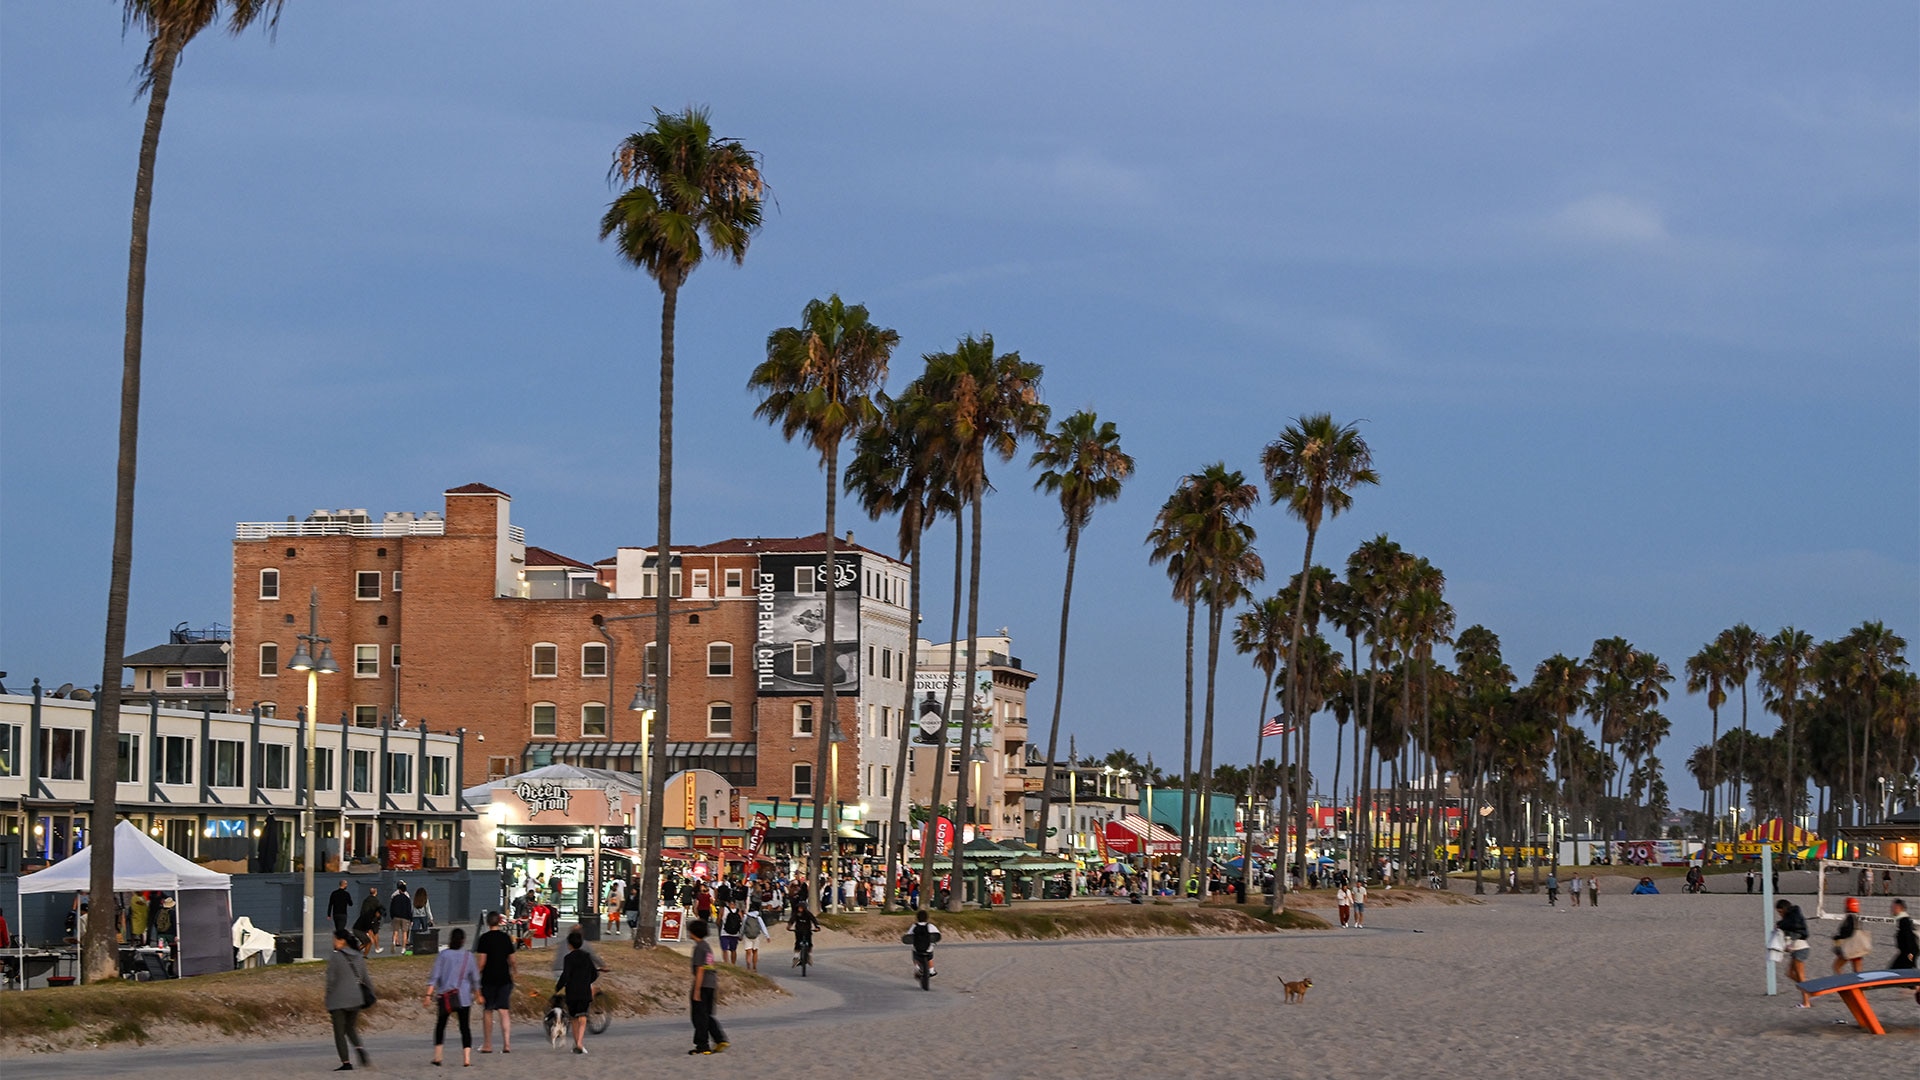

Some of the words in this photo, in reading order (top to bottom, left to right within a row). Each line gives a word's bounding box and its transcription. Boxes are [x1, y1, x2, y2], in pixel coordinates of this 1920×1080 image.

[817, 564, 857, 582] 805
[759, 573, 775, 644] PROPERLY
[759, 649, 774, 689] CHILL
[750, 829, 760, 850] ICE
[936, 823, 947, 854] CORN
